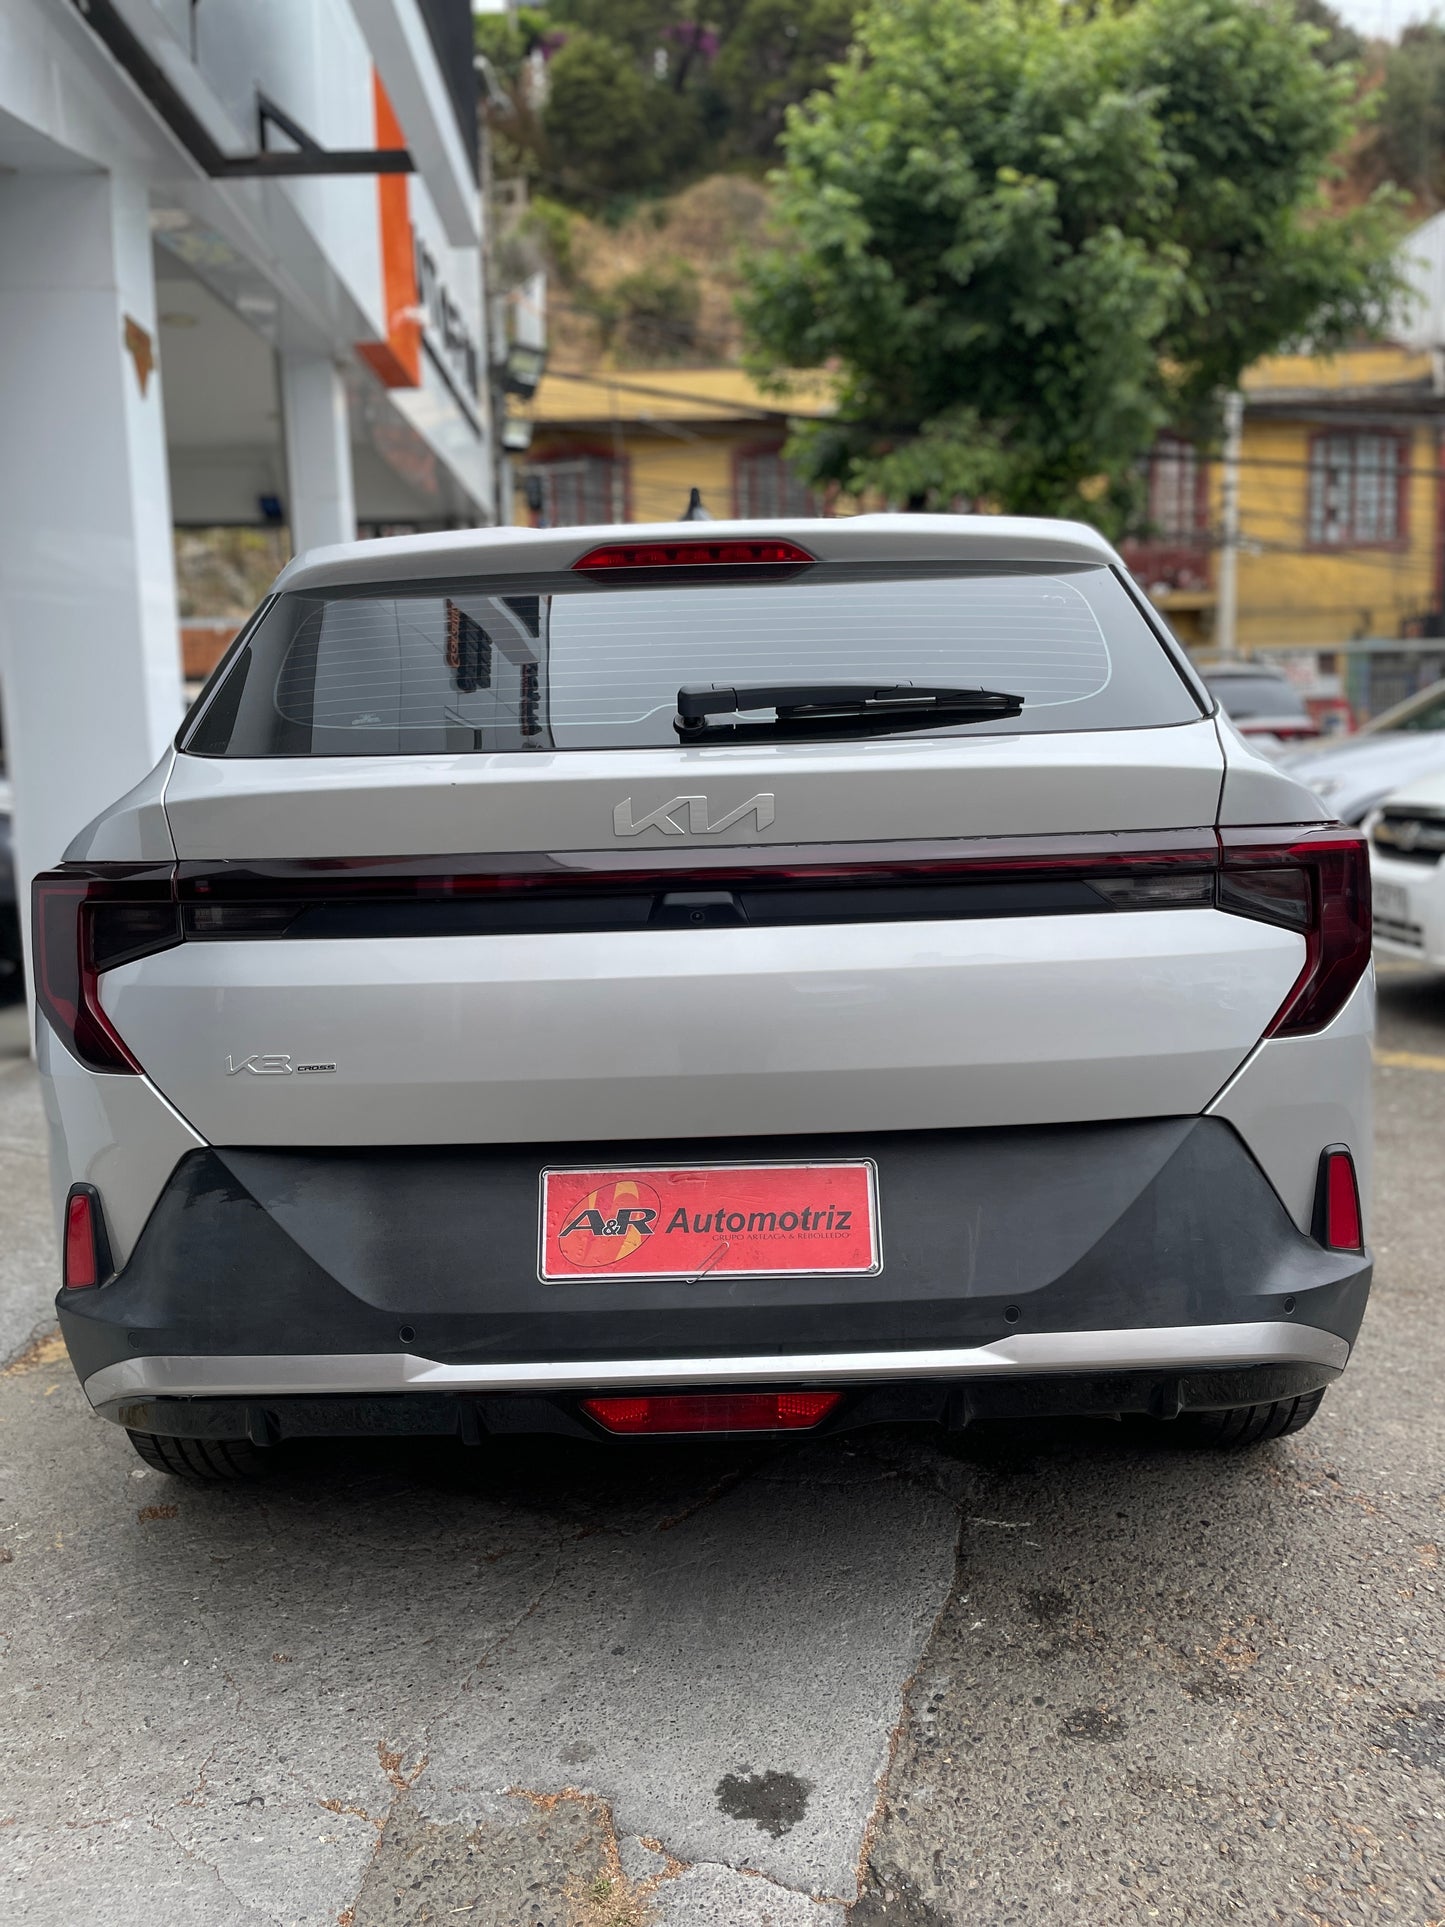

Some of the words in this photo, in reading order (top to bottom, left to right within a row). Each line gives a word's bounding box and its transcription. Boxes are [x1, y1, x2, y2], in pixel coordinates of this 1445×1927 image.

[613, 792, 775, 837] KIA
[225, 1054, 293, 1075] K3
[297, 1063, 336, 1073] CROSS
[558, 1208, 658, 1237] A&R
[665, 1205, 852, 1234] Automotriz
[797, 1232, 850, 1240] REBOLLEDO
